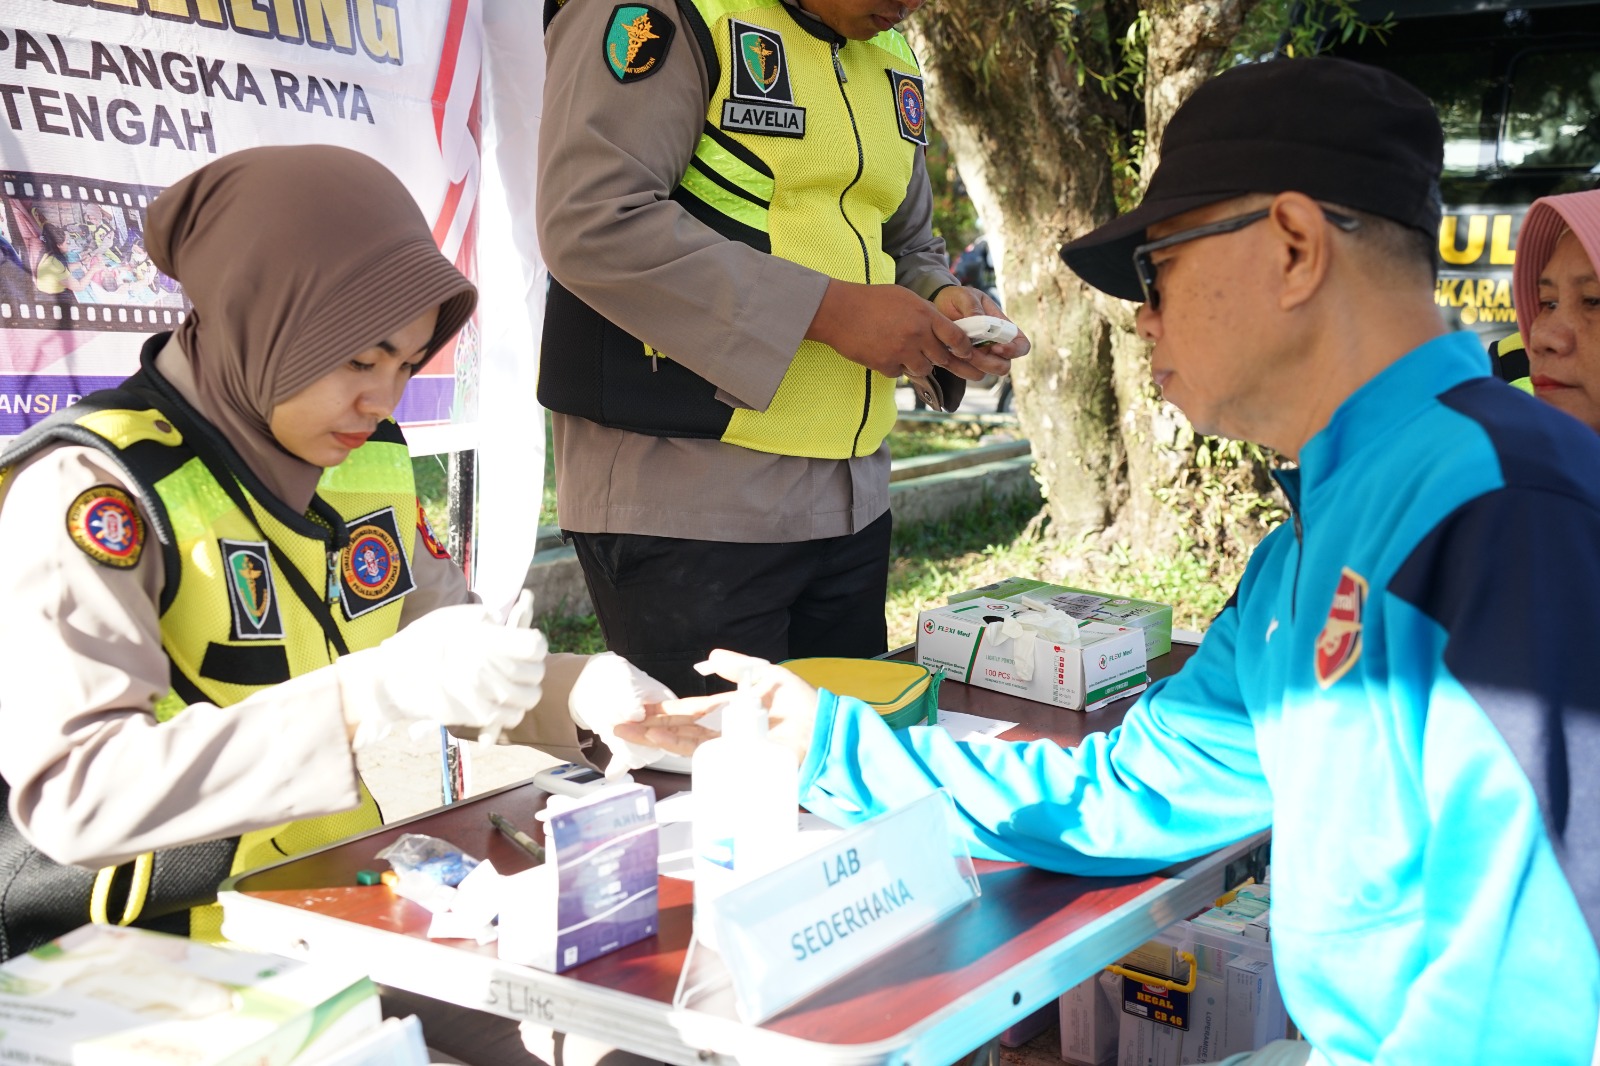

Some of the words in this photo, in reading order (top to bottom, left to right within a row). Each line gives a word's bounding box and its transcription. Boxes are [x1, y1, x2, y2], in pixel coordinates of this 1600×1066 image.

[270, 68, 375, 125] RAYA
[0, 83, 217, 154] TENGAH
[729, 106, 800, 130] LAVELIA
[937, 625, 956, 635] FLEXI
[956, 628, 971, 638] Med
[985, 668, 997, 677] 100
[997, 671, 1011, 680] PCS
[822, 847, 861, 887] LAB
[790, 878, 915, 961] SEDERHANA
[1136, 991, 1174, 1010] REGAL
[1154, 1010, 1167, 1022] CB
[1170, 1015, 1183, 1026] 46
[1201, 1011, 1212, 1059] LOPERAMIDE
